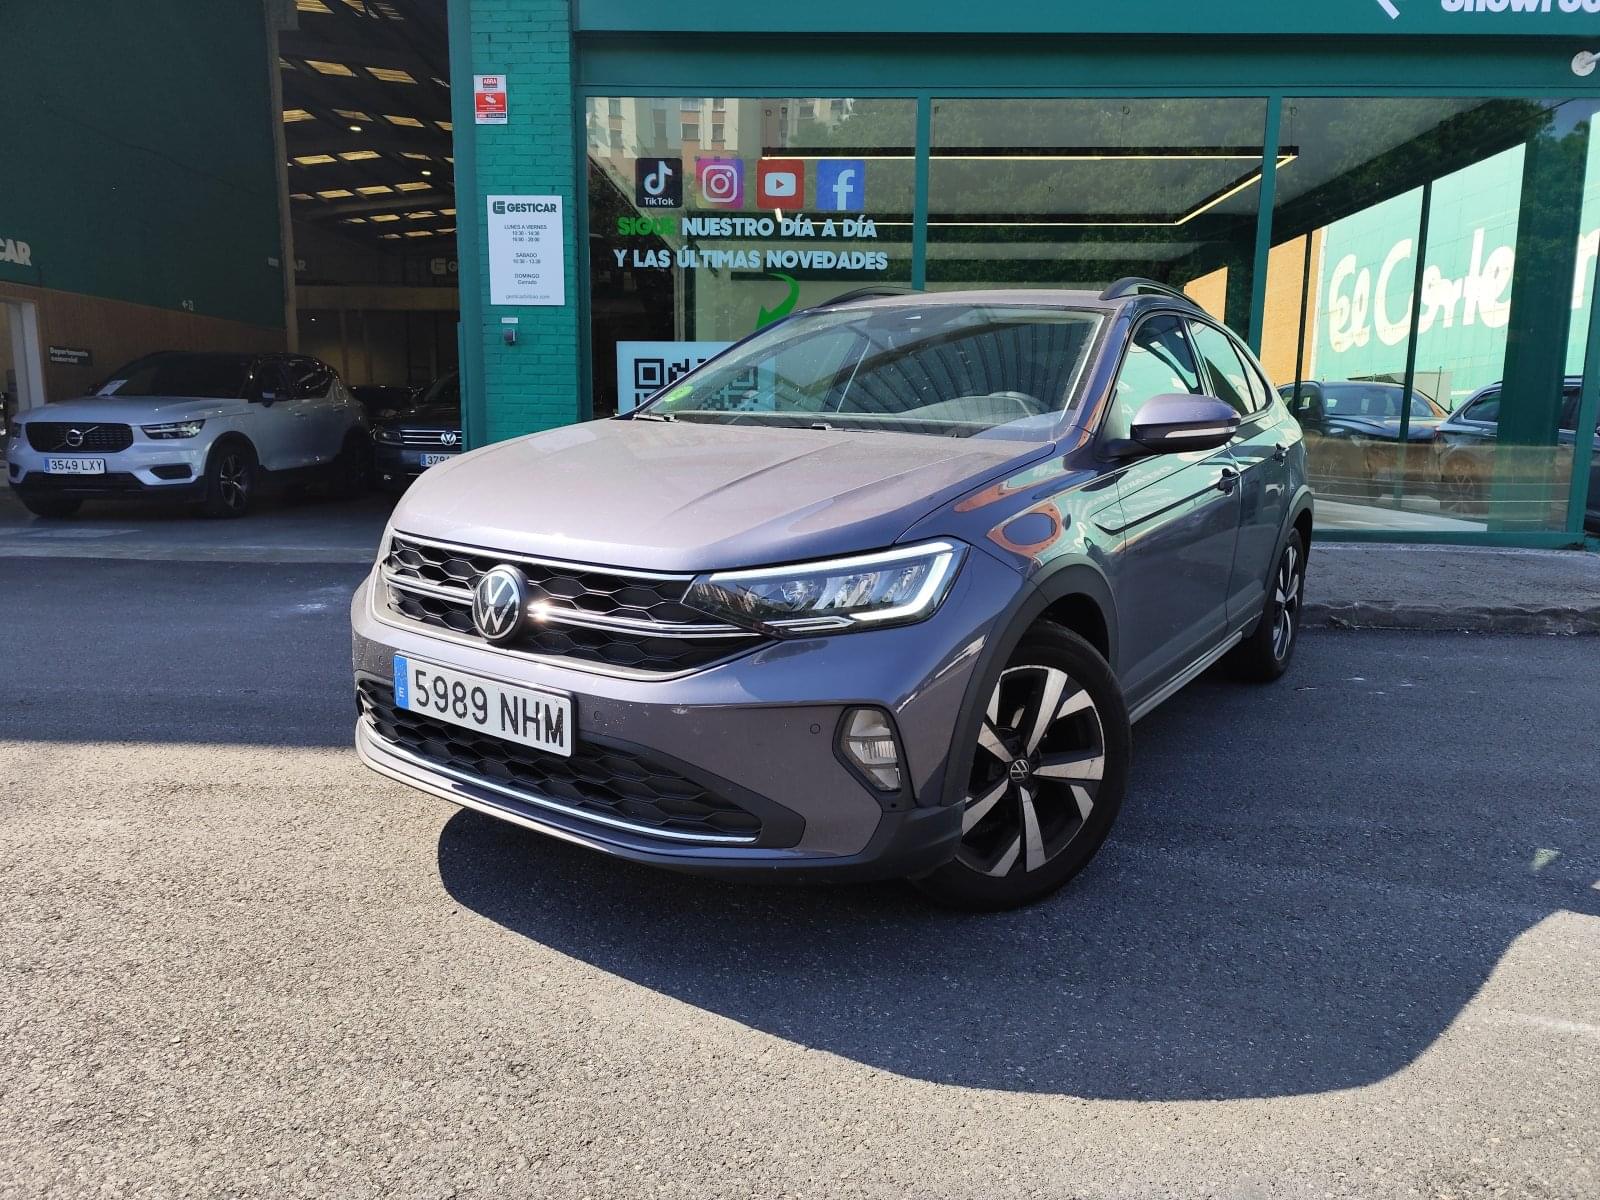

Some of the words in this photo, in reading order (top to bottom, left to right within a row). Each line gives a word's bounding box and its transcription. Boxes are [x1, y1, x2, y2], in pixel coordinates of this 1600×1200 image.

[644, 197, 674, 206] TikTok
[507, 203, 557, 213] GESTICAR
[617, 217, 675, 236] SIGUE
[682, 217, 774, 236] NUESTRO
[781, 213, 815, 237] DÍA
[821, 219, 836, 238] A
[843, 214, 877, 238] DÍA
[613, 249, 628, 268] Y
[633, 249, 671, 268] LAS
[677, 244, 760, 269] ÚLTIMAS
[766, 251, 888, 270] NOVEDADES
[51, 459, 78, 471] 3549
[82, 460, 102, 471] LXY
[427, 455, 450, 464] 379
[414, 669, 489, 725] 5989
[500, 691, 564, 748] NHM
